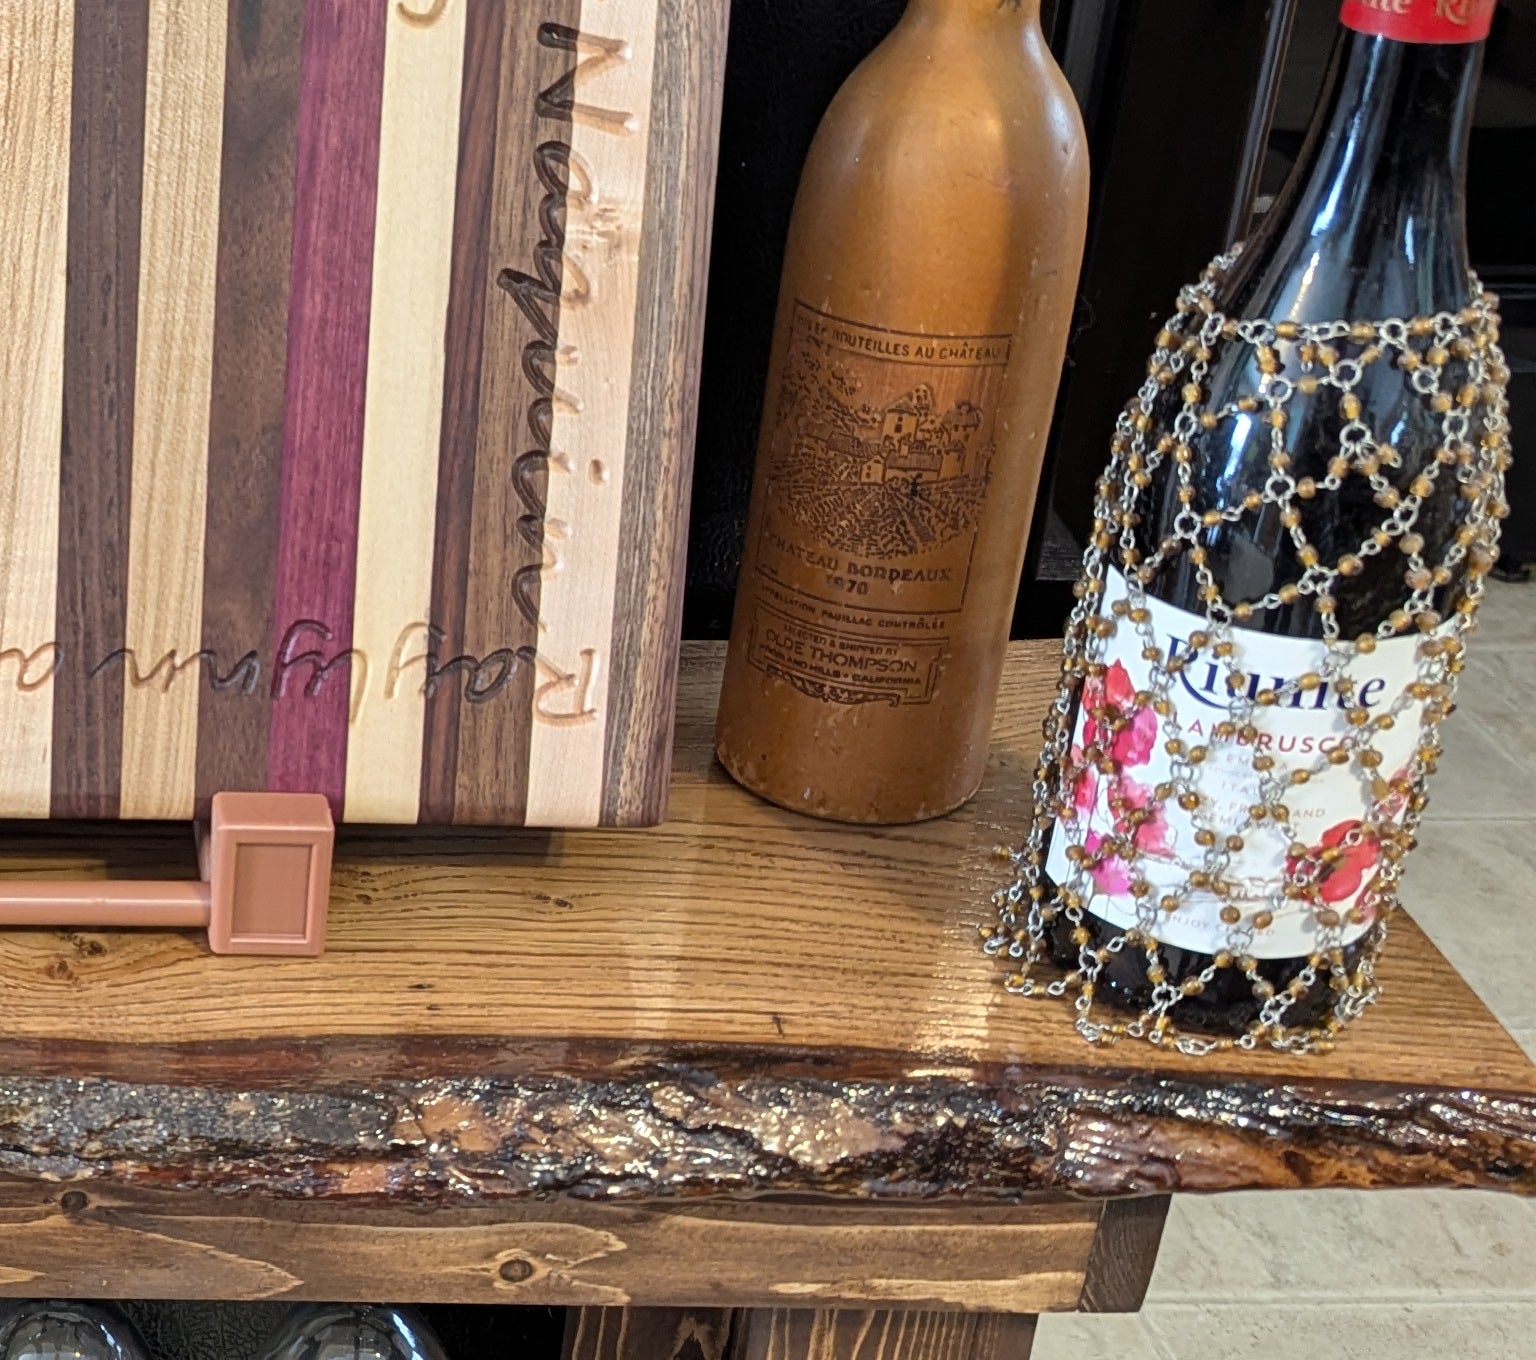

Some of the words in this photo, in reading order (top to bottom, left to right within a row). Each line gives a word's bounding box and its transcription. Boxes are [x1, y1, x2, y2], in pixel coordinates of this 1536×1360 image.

[496, 22, 641, 632] Naquin
[915, 346, 935, 361] AU
[846, 562, 952, 583] BORDEAUX
[91, 618, 600, 725] Raylynn
[766, 627, 805, 656] OLDE
[810, 644, 918, 673] THOMPSON
